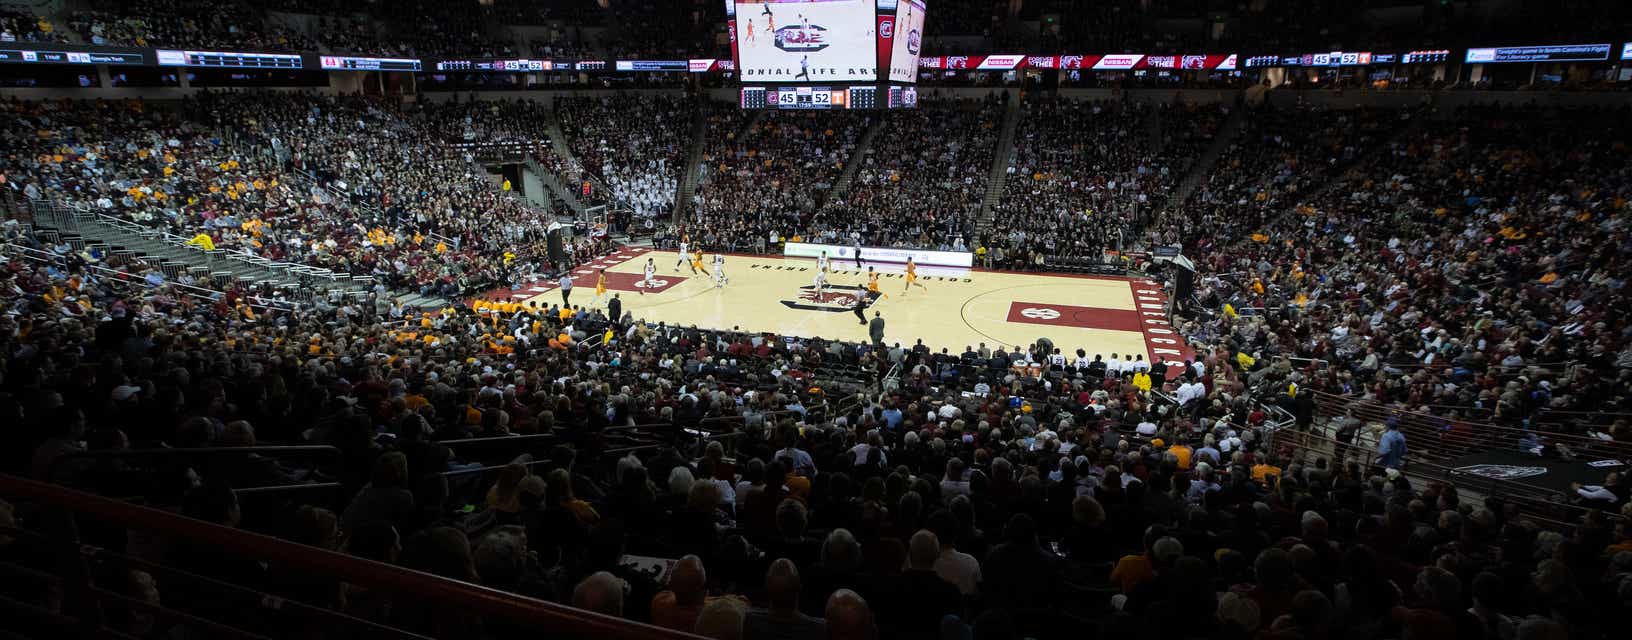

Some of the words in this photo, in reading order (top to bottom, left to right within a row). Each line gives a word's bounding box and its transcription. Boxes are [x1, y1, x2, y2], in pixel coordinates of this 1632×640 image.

[1315, 55, 1328, 63] 45
[1344, 55, 1356, 63] 52
[506, 61, 517, 69] 45
[530, 61, 541, 69] 52
[780, 93, 794, 103] 45
[815, 93, 829, 103] 52
[750, 264, 809, 272] ARENA
[876, 272, 973, 283] COLOIAL
[1136, 289, 1185, 368] GAMECOCKS
